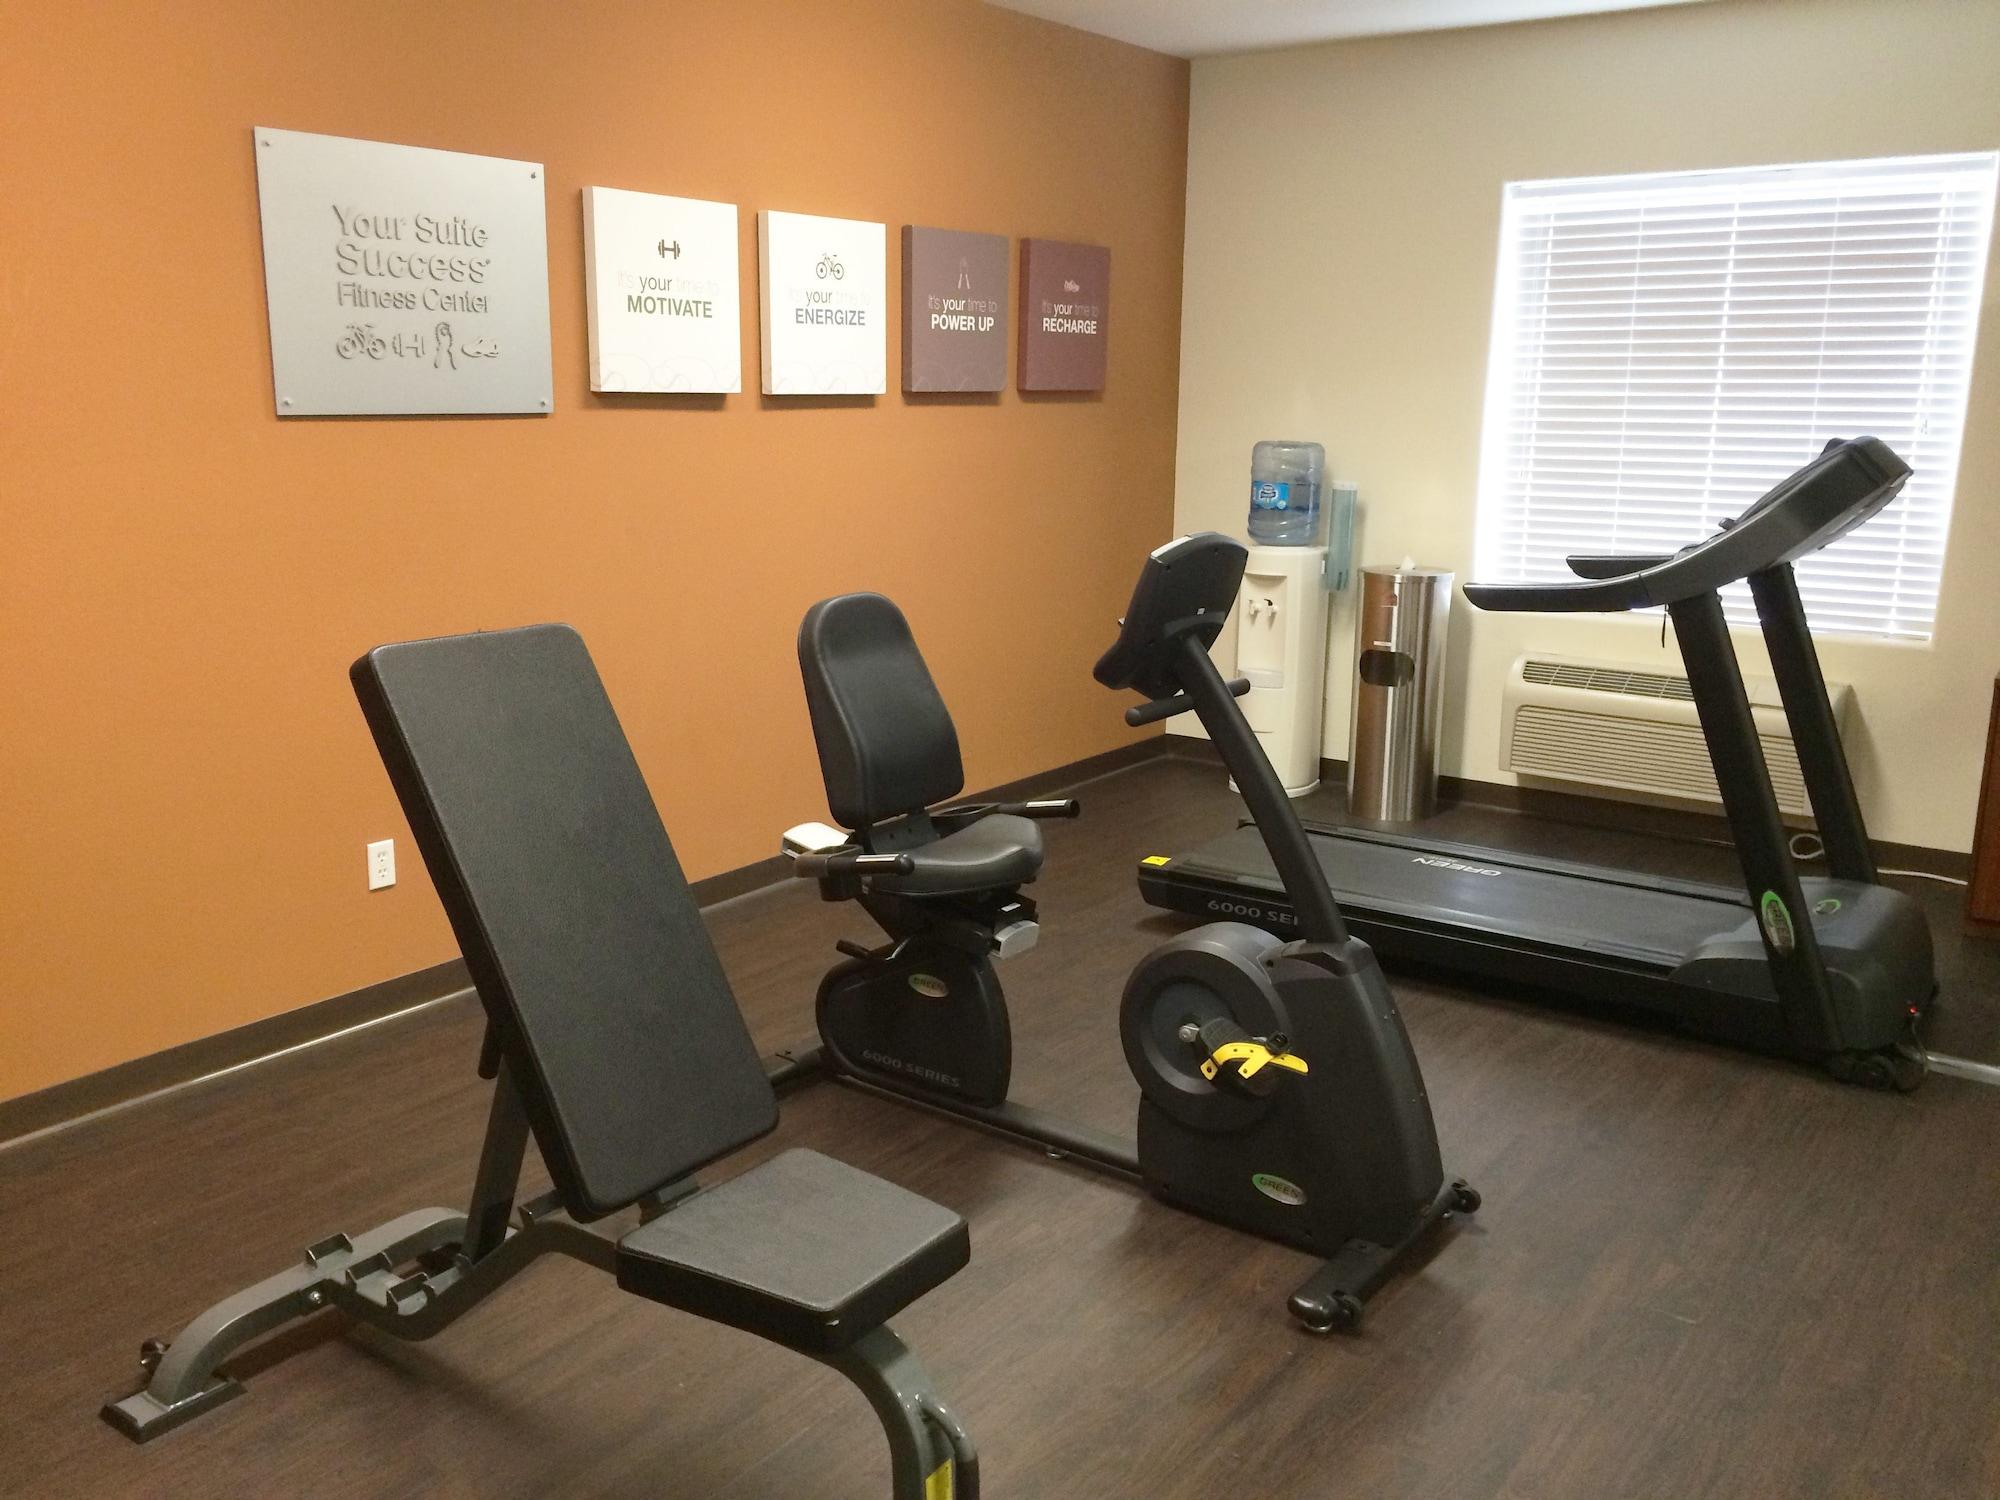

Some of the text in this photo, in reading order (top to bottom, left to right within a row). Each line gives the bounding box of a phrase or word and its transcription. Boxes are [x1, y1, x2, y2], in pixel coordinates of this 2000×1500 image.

[332, 204, 488, 247] Your Suite
[336, 243, 487, 283] Success
[639, 275, 673, 294] your
[337, 281, 488, 313] Fitness Center
[627, 294, 713, 319] MOTIVATE
[806, 290, 833, 307] your
[942, 298, 966, 313] your
[795, 307, 866, 326] ENERGIZE
[1053, 303, 1073, 317] your
[931, 313, 995, 332] POWER UP
[1042, 317, 1098, 335] RECHARGE
[1207, 900, 1261, 918] 6000
[863, 1049, 961, 1088] 6000 SERIES
